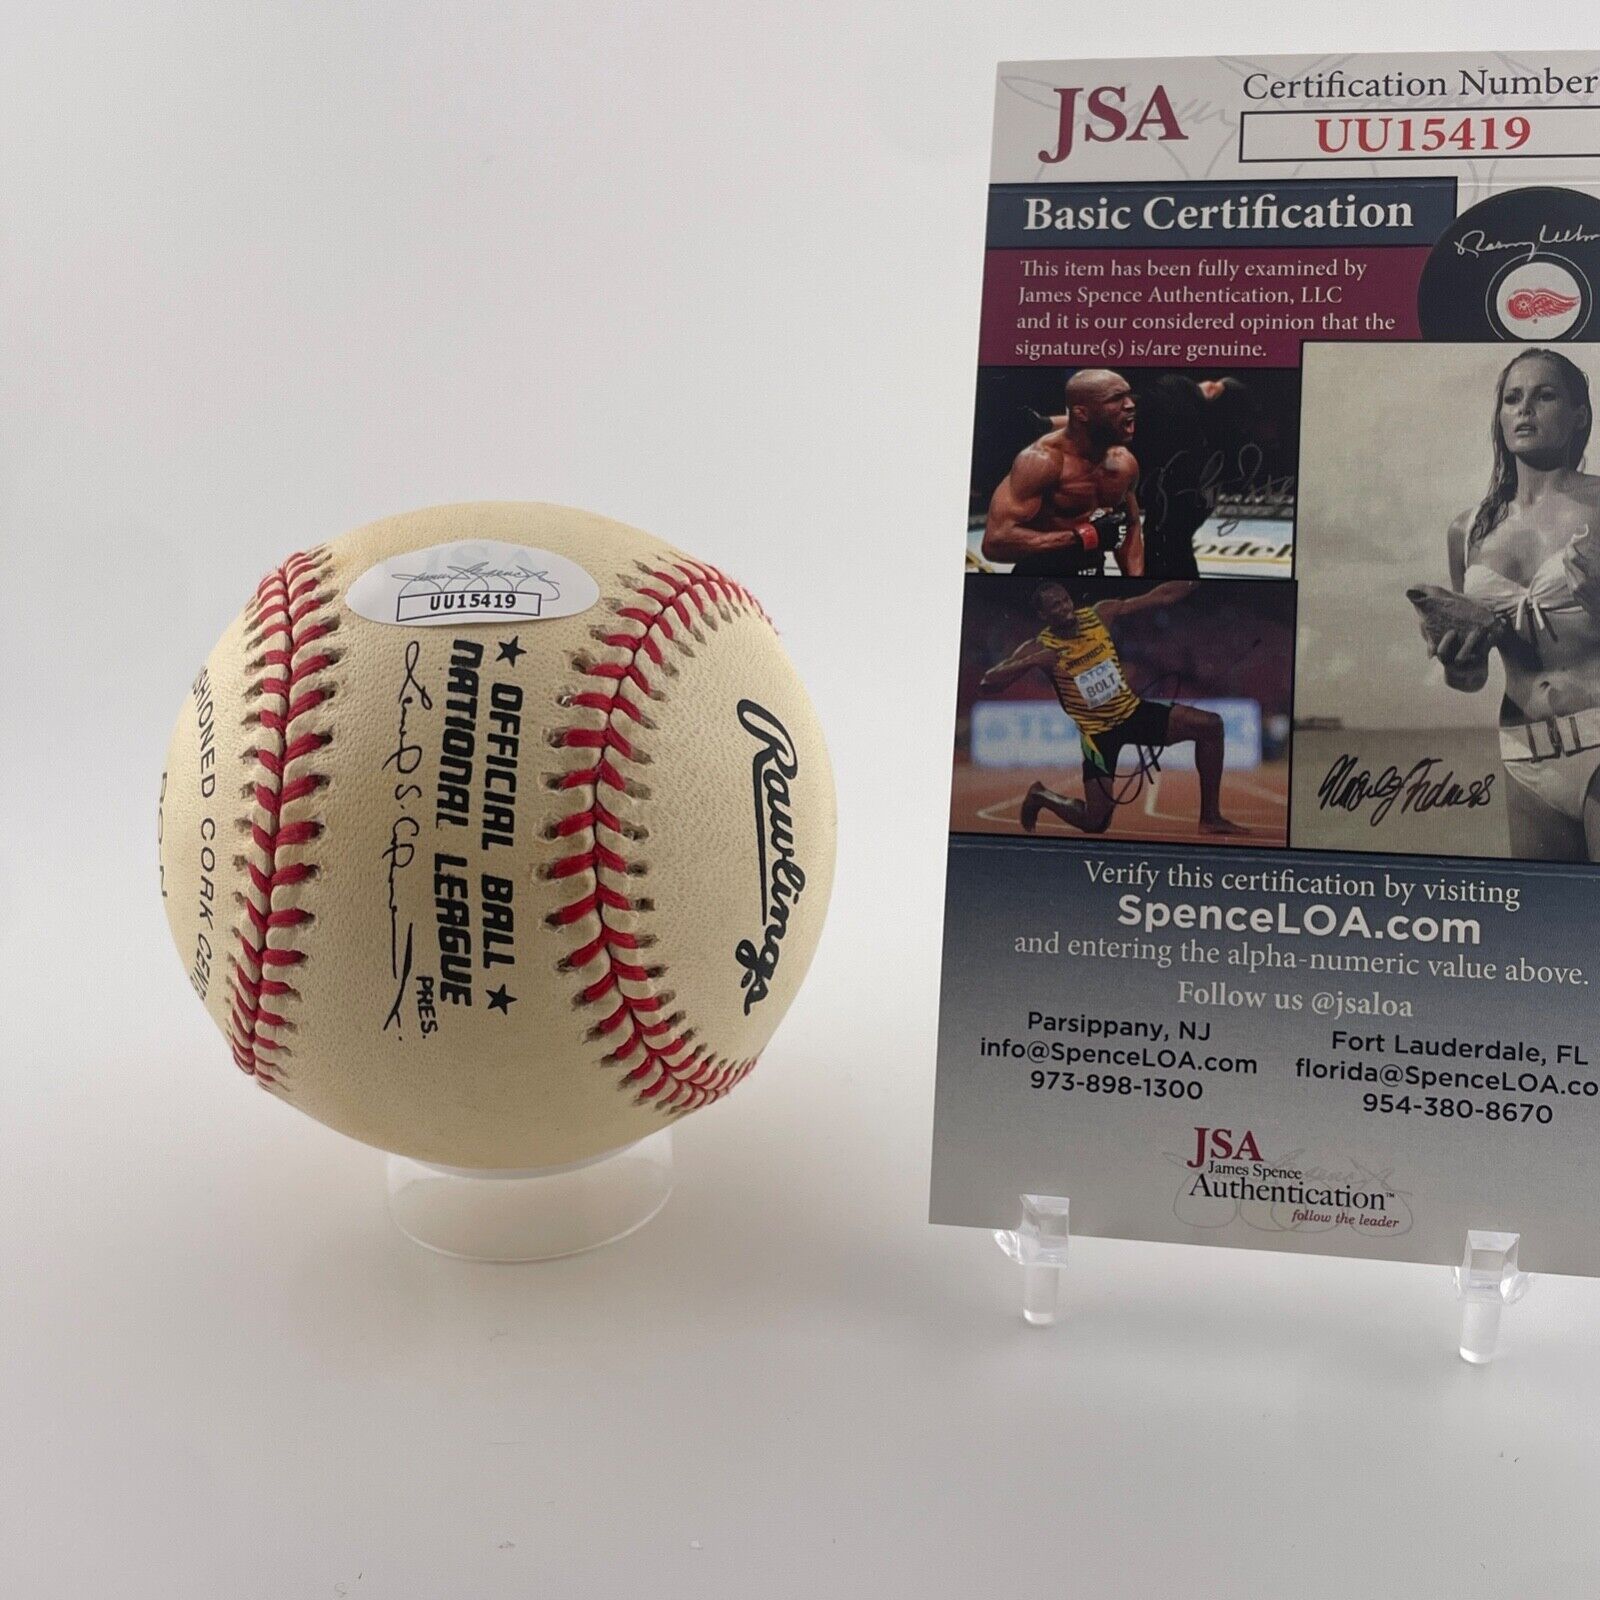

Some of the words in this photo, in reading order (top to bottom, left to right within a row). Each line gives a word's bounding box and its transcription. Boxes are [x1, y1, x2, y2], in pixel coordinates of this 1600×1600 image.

[1243, 71, 1448, 99] Certification
[1458, 67, 1599, 97] Number
[1038, 85, 1189, 163] JSA
[1315, 117, 1532, 153] UU15419
[1024, 197, 1131, 230] Basic
[1143, 194, 1414, 230] Certification
[1020, 260, 1058, 276] This
[1064, 261, 1104, 276] item
[1111, 260, 1141, 276] has
[1147, 260, 1191, 276] been
[1199, 259, 1239, 281] fully
[1244, 259, 1337, 276] examined
[1344, 259, 1367, 281] by
[1018, 287, 1072, 305] James
[1077, 286, 1142, 308] Spence
[1148, 286, 1294, 305] Authentication,
[1302, 286, 1342, 303] LLC
[1017, 312, 1050, 329] and
[1057, 313, 1069, 329] it
[1075, 313, 1089, 329] is
[1094, 317, 1127, 329] our
[1132, 312, 1234, 330] considered
[1241, 314, 1314, 335] opinion
[1322, 312, 1359, 330] that
[1365, 312, 1396, 330] the
[1015, 339, 1124, 361] signature(s)
[1130, 339, 1181, 357] is/are
[1186, 340, 1267, 362] genuine.
[430, 593, 517, 611] UU15419
[1086, 672, 1116, 698] BOLT
[436, 639, 484, 829] NATIONAL
[482, 682, 524, 850] OFFICIAL
[200, 817, 216, 930] CORK
[735, 699, 806, 1016] Rawlings
[1084, 860, 1160, 892] Verify
[1167, 863, 1213, 889] this
[1221, 868, 1376, 898] certification
[1385, 874, 1416, 906] by
[1423, 878, 1521, 912] visiting
[434, 852, 472, 1007] LEAGUE
[481, 874, 516, 969] BALL
[1117, 894, 1481, 945] SpenceLOA.com
[1014, 931, 1059, 955] and
[1067, 937, 1172, 969] entering
[1180, 938, 1220, 964] the
[1227, 941, 1420, 976] alpha-numeric
[1427, 953, 1497, 981] value
[1505, 957, 1589, 986] above.
[416, 975, 439, 1039] PRES.
[1177, 980, 1267, 1009] Follow
[1274, 993, 1303, 1011] us
[1311, 990, 1413, 1020] @jsaloa
[1028, 1011, 1169, 1042] Parsippany,
[1179, 1020, 1211, 1041] NJ
[980, 1037, 1257, 1074] info@SpenceLOA.com
[1332, 1030, 1385, 1052] Fort
[1395, 1034, 1547, 1066] Lauderdale,
[1557, 1045, 1588, 1065] FL
[1030, 1070, 1203, 1100] 973-898-1300
[1296, 1058, 1599, 1096] florida@SpenceLOA.co
[1363, 1093, 1553, 1124] 954-380-8670
[1187, 1127, 1264, 1168] JSA
[1208, 1160, 1249, 1176] James
[1253, 1164, 1302, 1181] Spence
[1291, 1209, 1331, 1223] follow
[1335, 1212, 1355, 1225] the
[1359, 1214, 1399, 1228] leader
